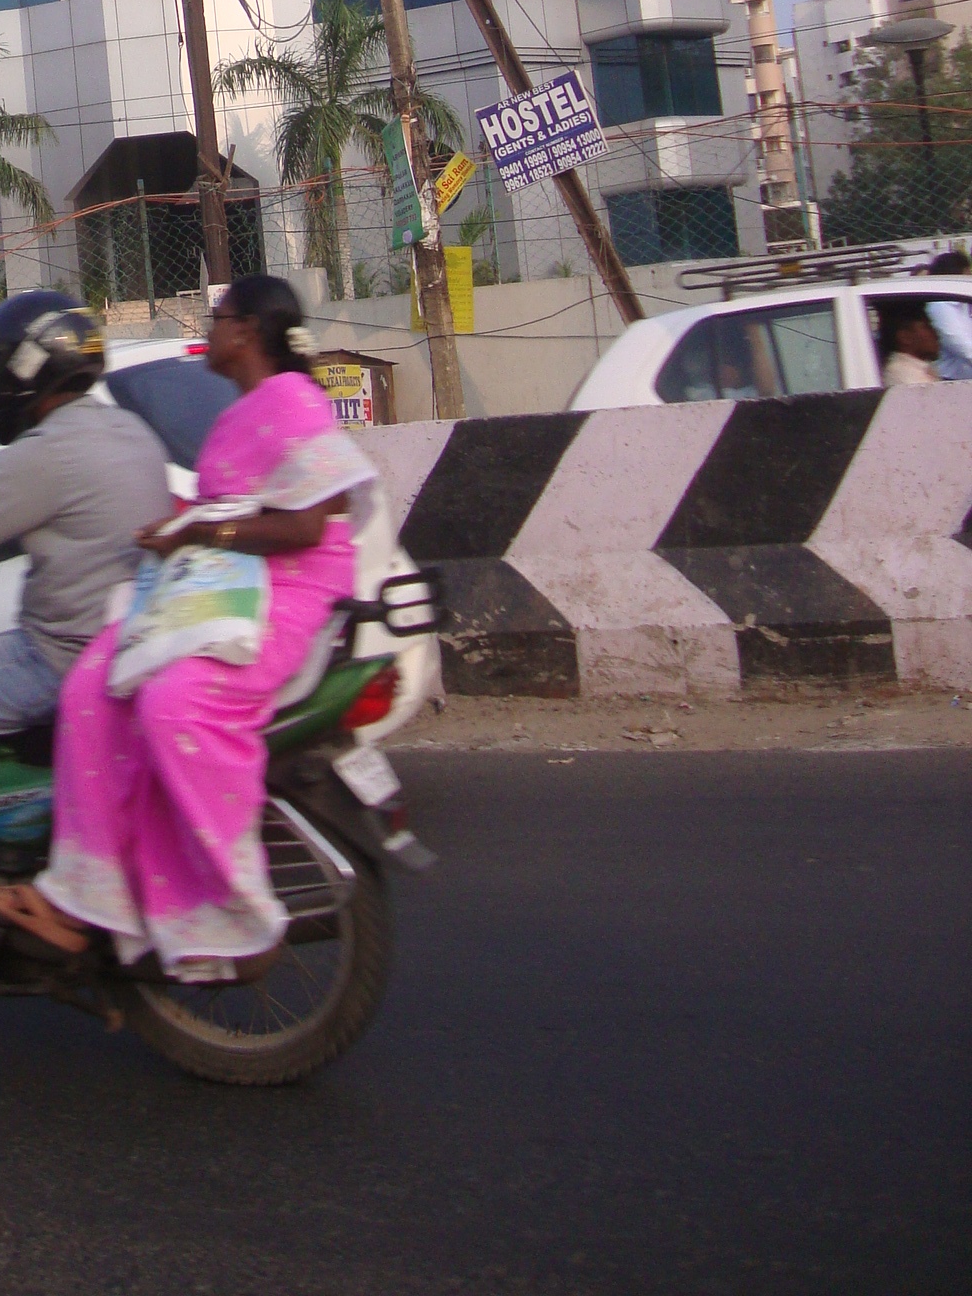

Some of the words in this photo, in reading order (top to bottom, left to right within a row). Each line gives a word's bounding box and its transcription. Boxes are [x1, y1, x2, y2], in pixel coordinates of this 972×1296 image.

[480, 82, 589, 149] HOSTEL
[497, 100, 510, 111] AR
[511, 91, 531, 105] NEW
[532, 81, 555, 95] BEST
[494, 135, 535, 161] (GENTS
[537, 131, 547, 141] &
[547, 111, 592, 137] LADIES)
[499, 160, 524, 179] 99401
[524, 150, 548, 169] 19999
[551, 139, 577, 157] 90954
[576, 128, 601, 147] 13000
[441, 172, 455, 189] Sai
[453, 158, 469, 176] Ram
[504, 173, 529, 192] 99621
[529, 163, 554, 182] 18523
[557, 151, 582, 170] 90954
[581, 141, 607, 160] 12222
[327, 366, 346, 375] NOW
[331, 398, 361, 419] IIT
